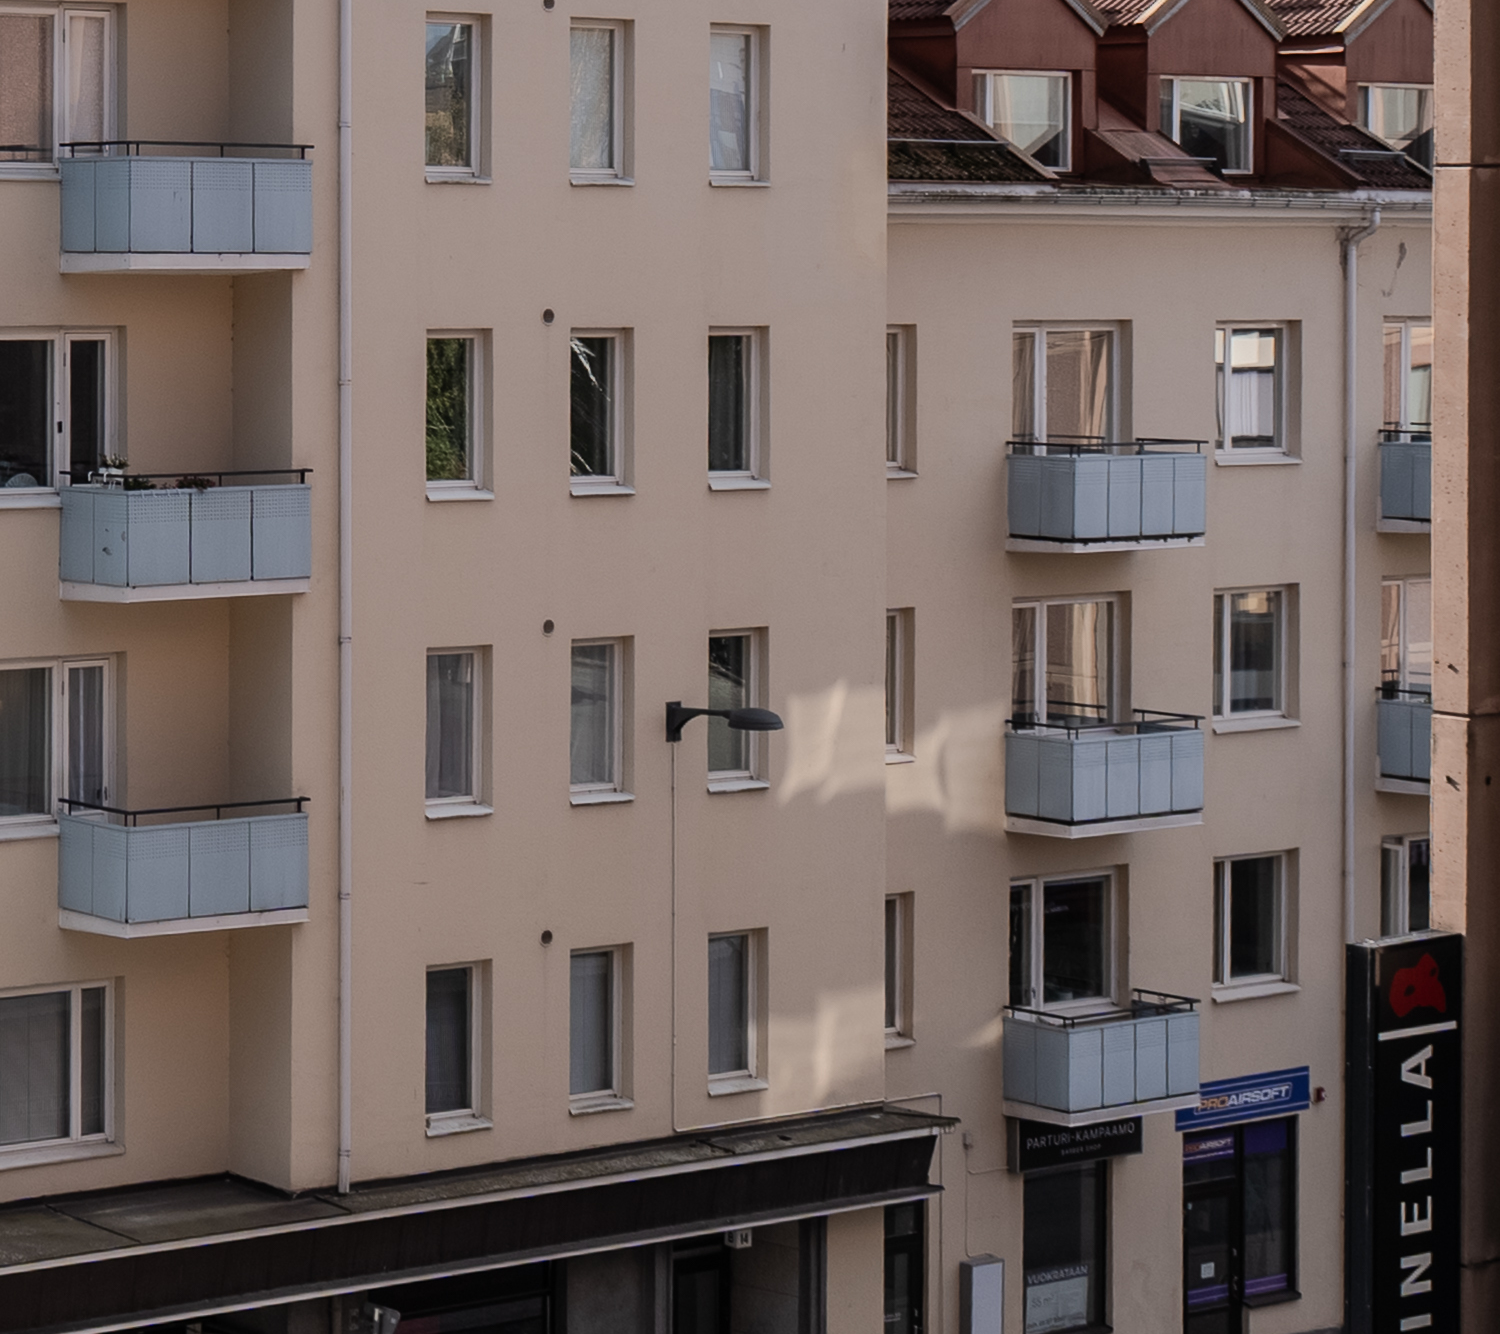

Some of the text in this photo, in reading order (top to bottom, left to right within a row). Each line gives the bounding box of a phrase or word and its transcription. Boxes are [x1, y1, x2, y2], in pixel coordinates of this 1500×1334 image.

[1198, 1085, 1290, 1111] PROAIRSOFT
[1026, 1122, 1135, 1150] PARTURI-KAMPAAMO
[1027, 1265, 1088, 1284] VUOKRATAAN
